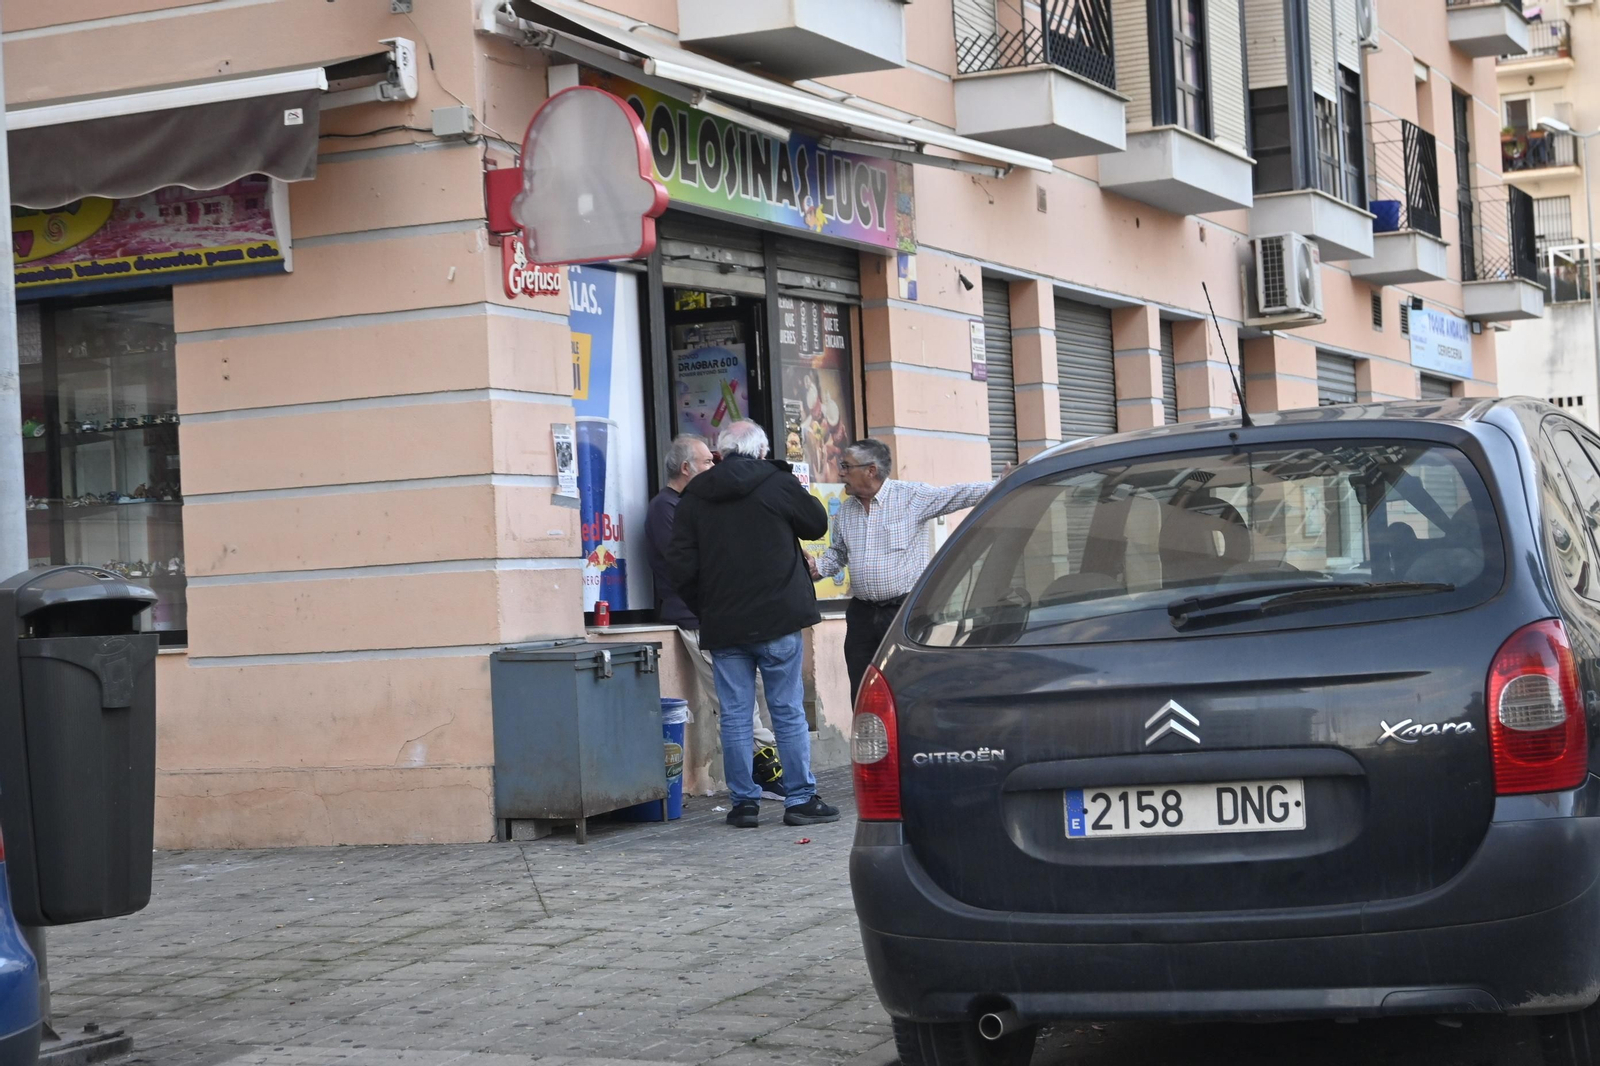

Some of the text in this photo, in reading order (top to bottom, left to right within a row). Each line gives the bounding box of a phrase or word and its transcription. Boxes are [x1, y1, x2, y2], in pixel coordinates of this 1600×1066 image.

[626, 95, 888, 232] OLOSINAS LUCY
[508, 263, 562, 295] Grefusa
[678, 356, 739, 372] DRAGBAR 600
[581, 512, 625, 542] ed Bull
[1376, 718, 1477, 745] Xsara
[912, 747, 1006, 766] CITROËN
[1090, 784, 1290, 831] 2158 DNG
[1072, 818, 1081, 829] E
